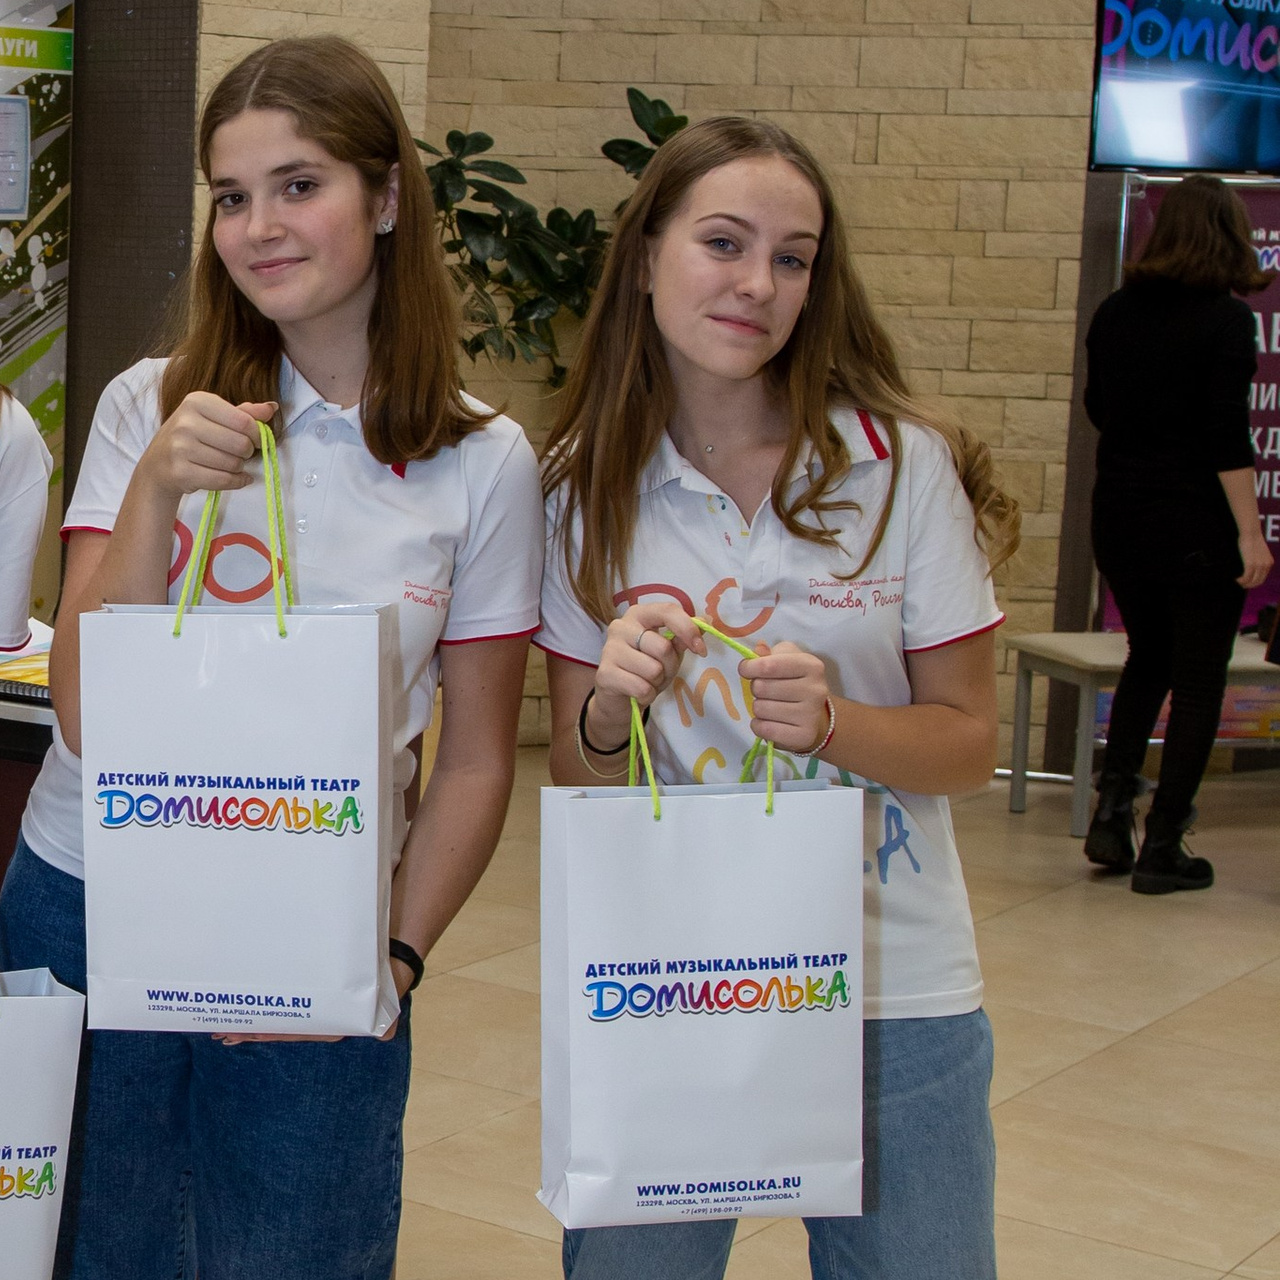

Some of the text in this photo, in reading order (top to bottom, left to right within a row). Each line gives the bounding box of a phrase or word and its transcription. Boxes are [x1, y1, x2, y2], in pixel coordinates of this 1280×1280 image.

[809, 590, 904, 616] Москва, Росси
[97, 771, 361, 792] ДЕТСКИЙ МУЗЫКАЛЬНЫЙ ТЕАТР
[97, 789, 360, 832] ДОМИСОЛЬКА
[586, 953, 847, 977] ДЕТСКИЙ МУЗЫКАЛЬНЫЙ ТЕАТР
[147, 989, 311, 1008] WWW.DOMISOLKA.RU
[586, 970, 847, 1017] ДОМИСОЛЬКА
[177, 1006, 207, 1014] МОСКВА,
[222, 1008, 261, 1016] МАРШАЛА
[262, 1010, 304, 1018] БИРЮЗОВА,
[16, 1145, 57, 1159] ТЕАТР
[637, 1176, 801, 1196] WWW.DOMISOLKA.RU
[713, 1195, 752, 1203] МАРШАЛА
[753, 1193, 795, 1201] БИРЮЗОВА,
